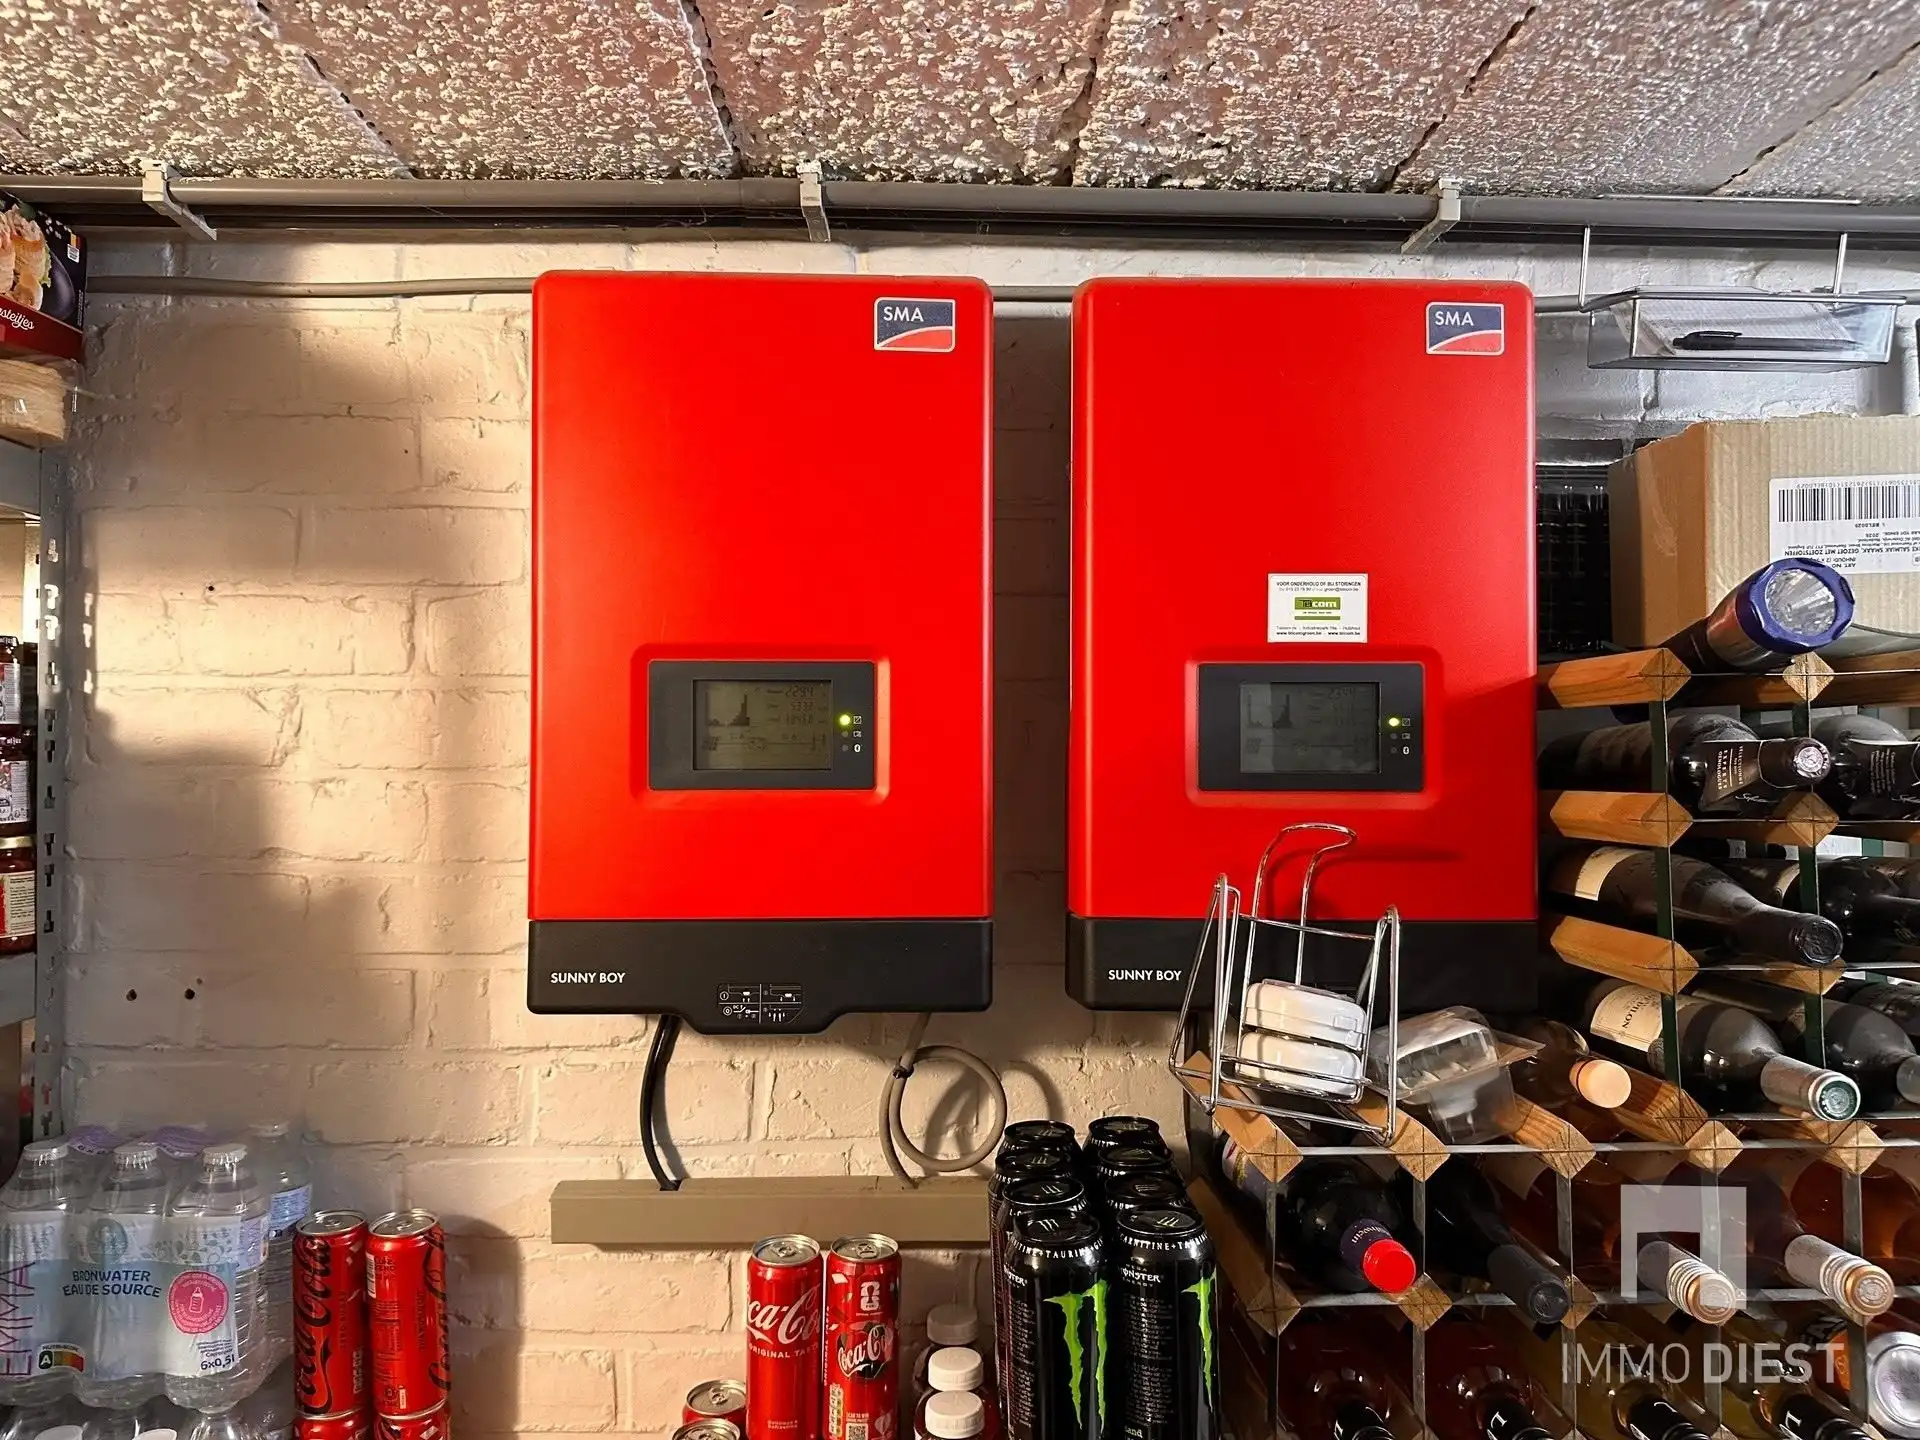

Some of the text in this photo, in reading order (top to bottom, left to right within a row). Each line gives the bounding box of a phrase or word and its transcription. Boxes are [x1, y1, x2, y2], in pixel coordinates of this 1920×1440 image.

[883, 306, 924, 322] SMA
[1434, 310, 1474, 326] SMA
[550, 972, 626, 984] SUNNY BOY
[1108, 968, 1182, 982] SUNNY BOY
[72, 1270, 151, 1282] BRONWATER
[84, 1284, 99, 1295] DE
[101, 1283, 162, 1298] SOURCE
